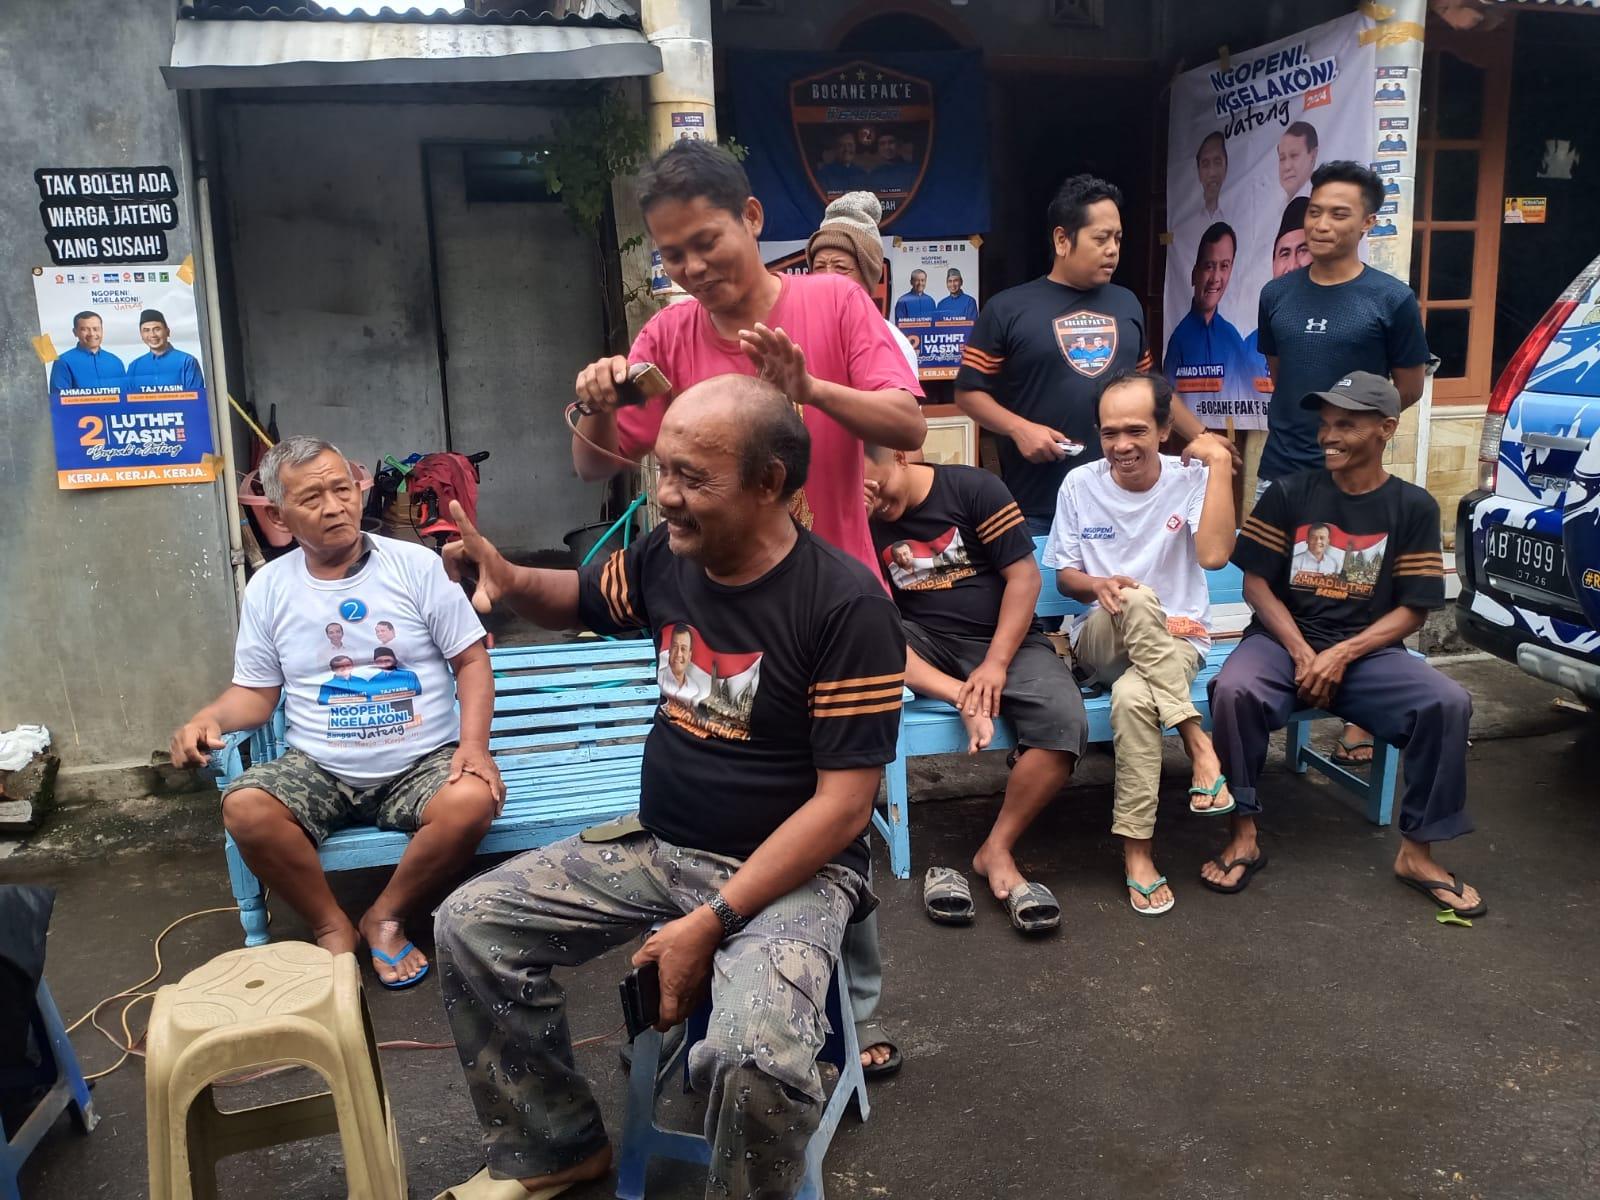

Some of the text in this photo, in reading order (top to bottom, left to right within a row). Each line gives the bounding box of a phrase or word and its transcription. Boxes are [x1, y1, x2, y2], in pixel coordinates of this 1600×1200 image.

[1210, 45, 1307, 92] NGOPENI.
[812, 83, 912, 99] BOCAHE PAK'E
[1216, 60, 1337, 115] NGELAKONI.
[1224, 100, 1290, 140] Jateng
[42, 172, 171, 196] TAK BOLEH ADA
[47, 203, 172, 228] WARGA JATENG
[53, 235, 161, 259] YANG SUSAH!
[924, 333, 965, 344] LUTHFI
[924, 344, 960, 355] YASIN
[923, 370, 948, 378] KERJA.
[1199, 365, 1224, 376] LUTHFI
[60, 386, 121, 396] AHMAD LUTHFI
[140, 385, 157, 393] TAJ
[1196, 400, 1233, 416] #BOCAHE
[110, 412, 185, 429] LUTHFI
[78, 415, 106, 447] 2
[112, 428, 176, 445] YASIN
[67, 467, 208, 484] KERJA. KERJA. KERJA.
[1489, 531, 1508, 558] AB
[1516, 537, 1554, 572] 1999
[343, 602, 362, 620] 2
[330, 703, 395, 717] NGOPENI.
[330, 711, 412, 727] NGELAKONI.
[357, 725, 405, 740] Jateng
